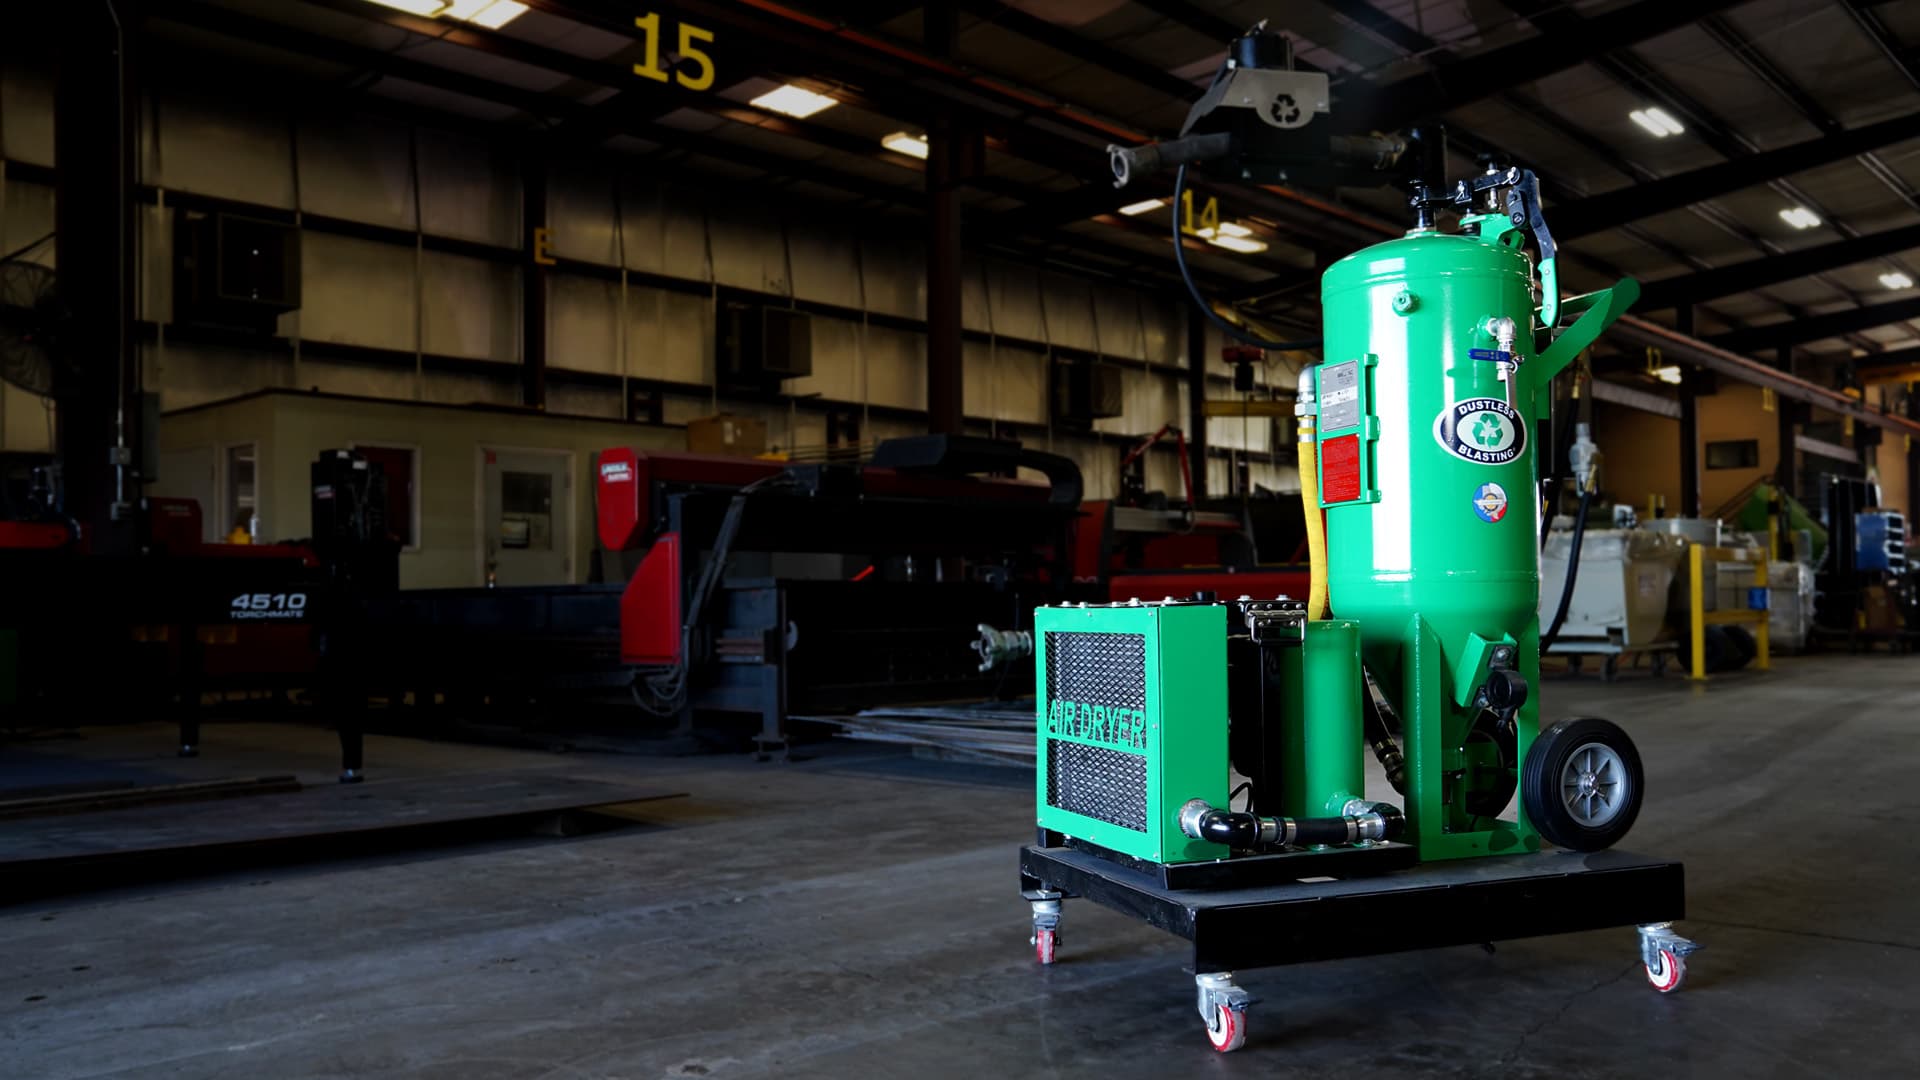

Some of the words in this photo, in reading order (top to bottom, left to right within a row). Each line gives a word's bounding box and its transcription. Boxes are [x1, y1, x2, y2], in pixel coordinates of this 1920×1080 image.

[633, 11, 715, 91] 15
[1181, 189, 1219, 241] 14
[533, 226, 557, 266] E
[1458, 400, 1515, 419] DUSTLESS
[231, 593, 307, 609] 4510
[1047, 699, 1076, 738] AIR
[1080, 703, 1146, 750] DRYER
